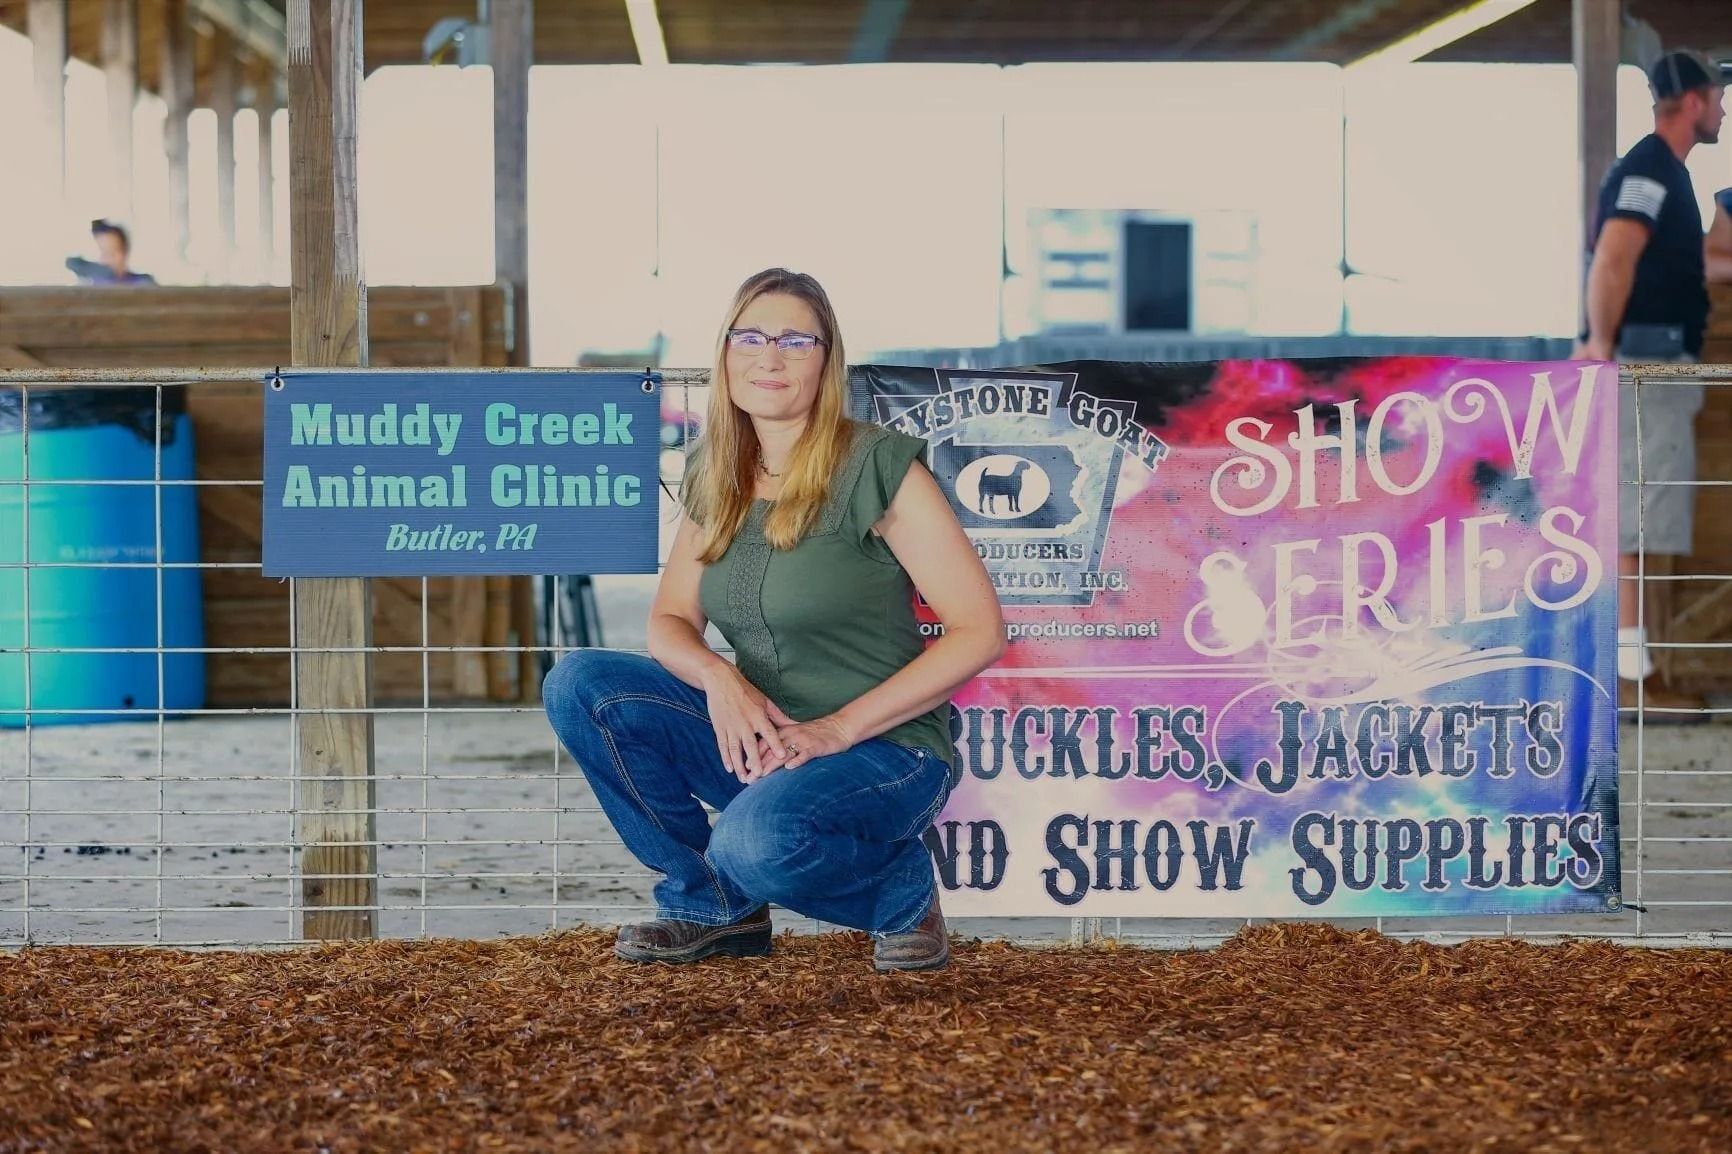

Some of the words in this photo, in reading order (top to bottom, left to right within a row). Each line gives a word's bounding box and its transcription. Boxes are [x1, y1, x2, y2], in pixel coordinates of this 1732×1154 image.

[290, 402, 463, 456] Muddy
[484, 402, 634, 446] Creek
[882, 384, 1050, 439] EYSTONE
[1066, 391, 1171, 474] GOAT
[1209, 364, 1604, 517] SHOW
[281, 464, 467, 508] Animal
[490, 464, 642, 508] Clinic
[385, 523, 487, 555] Butler,
[495, 523, 539, 552] PA
[975, 542, 1084, 561] ODUCERS
[1079, 571, 1129, 591] INC.
[1183, 505, 1603, 657] SERIES
[1253, 699, 1564, 796] JACKETS
[922, 819, 1010, 891] ND
[1041, 812, 1255, 906] SHOW
[1288, 811, 1602, 906] SUPPLIES
